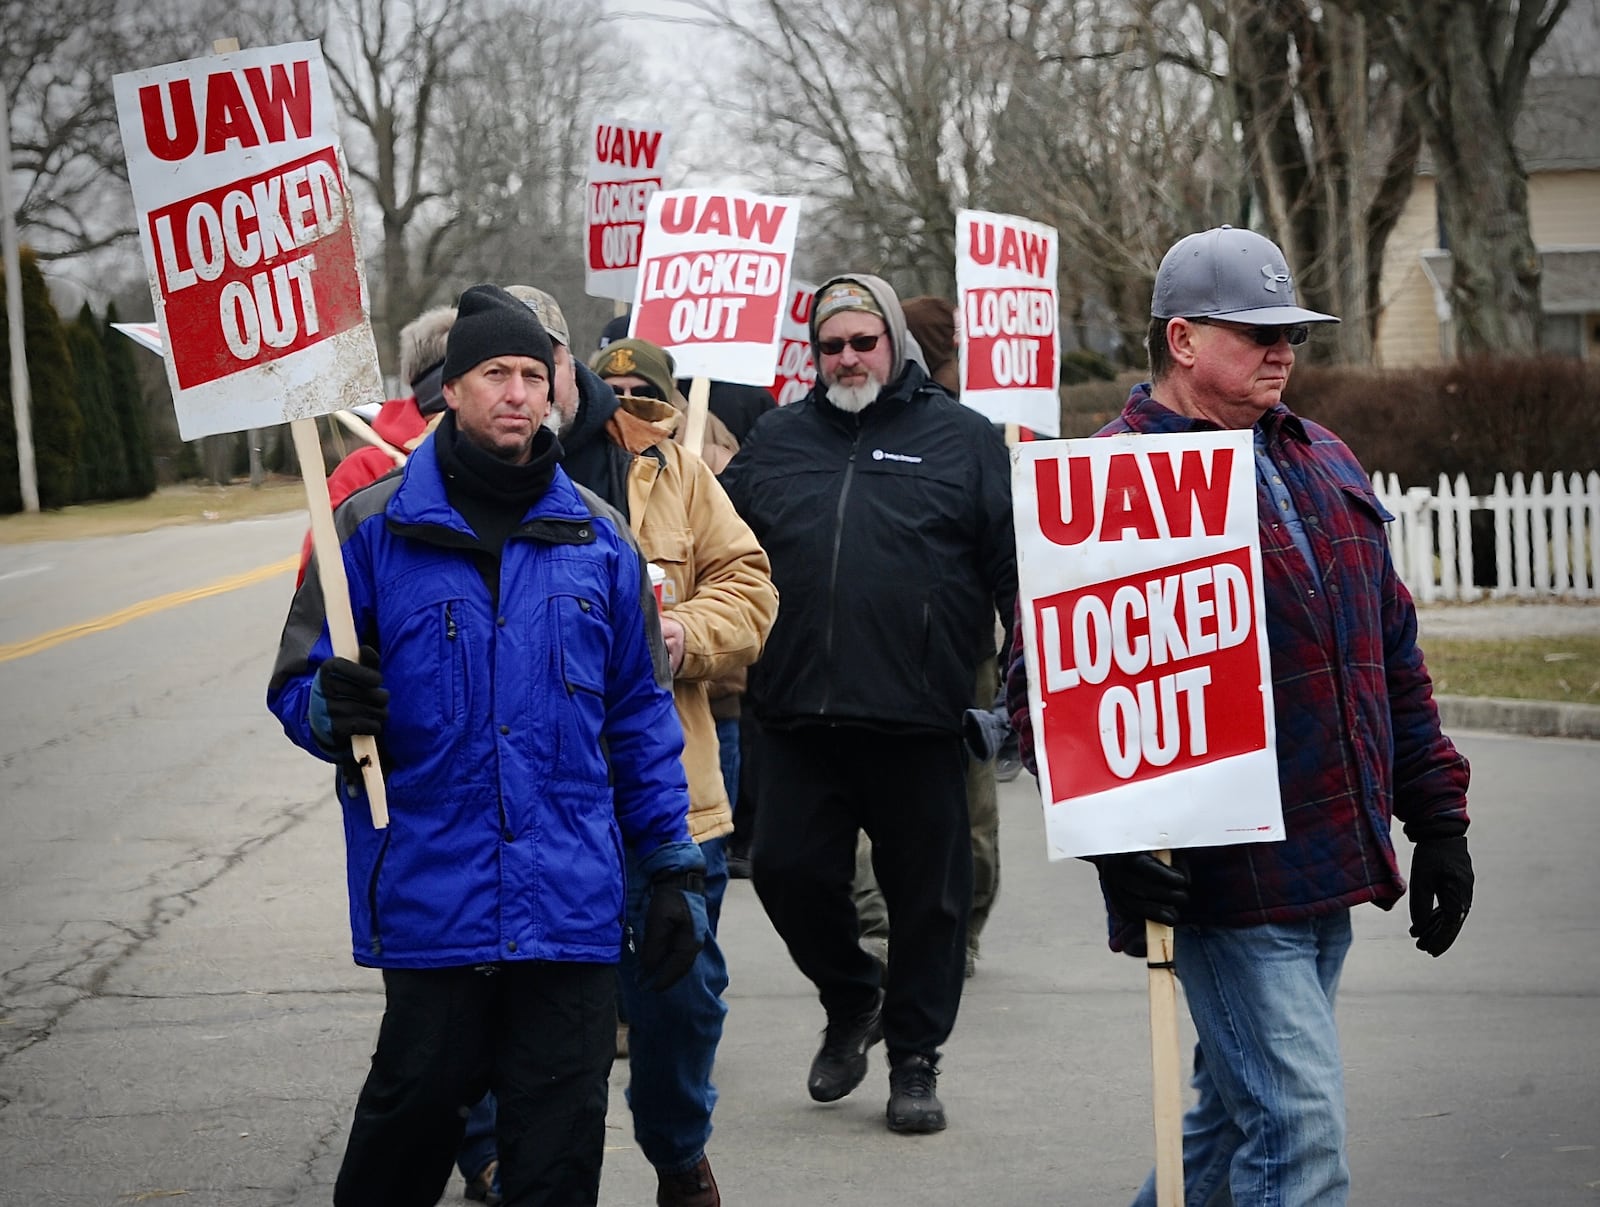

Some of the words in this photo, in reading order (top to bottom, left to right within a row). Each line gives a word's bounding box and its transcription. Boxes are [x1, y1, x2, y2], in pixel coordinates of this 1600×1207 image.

[138, 60, 312, 161] UAW
[596, 125, 663, 168] UAW
[154, 159, 344, 293] LOCKED
[589, 182, 661, 225] LOCKE
[660, 196, 787, 245] UAW
[602, 225, 641, 267] OUT
[969, 221, 1048, 278] UAW
[645, 252, 781, 300] LOCKED
[218, 254, 318, 361] OUT
[668, 297, 747, 343] OUT
[967, 290, 1054, 338] LOCKED
[991, 338, 1040, 386] OUT
[1034, 448, 1234, 546] UAW
[1040, 563, 1252, 693] LOCKED
[1098, 666, 1211, 780] OUT
